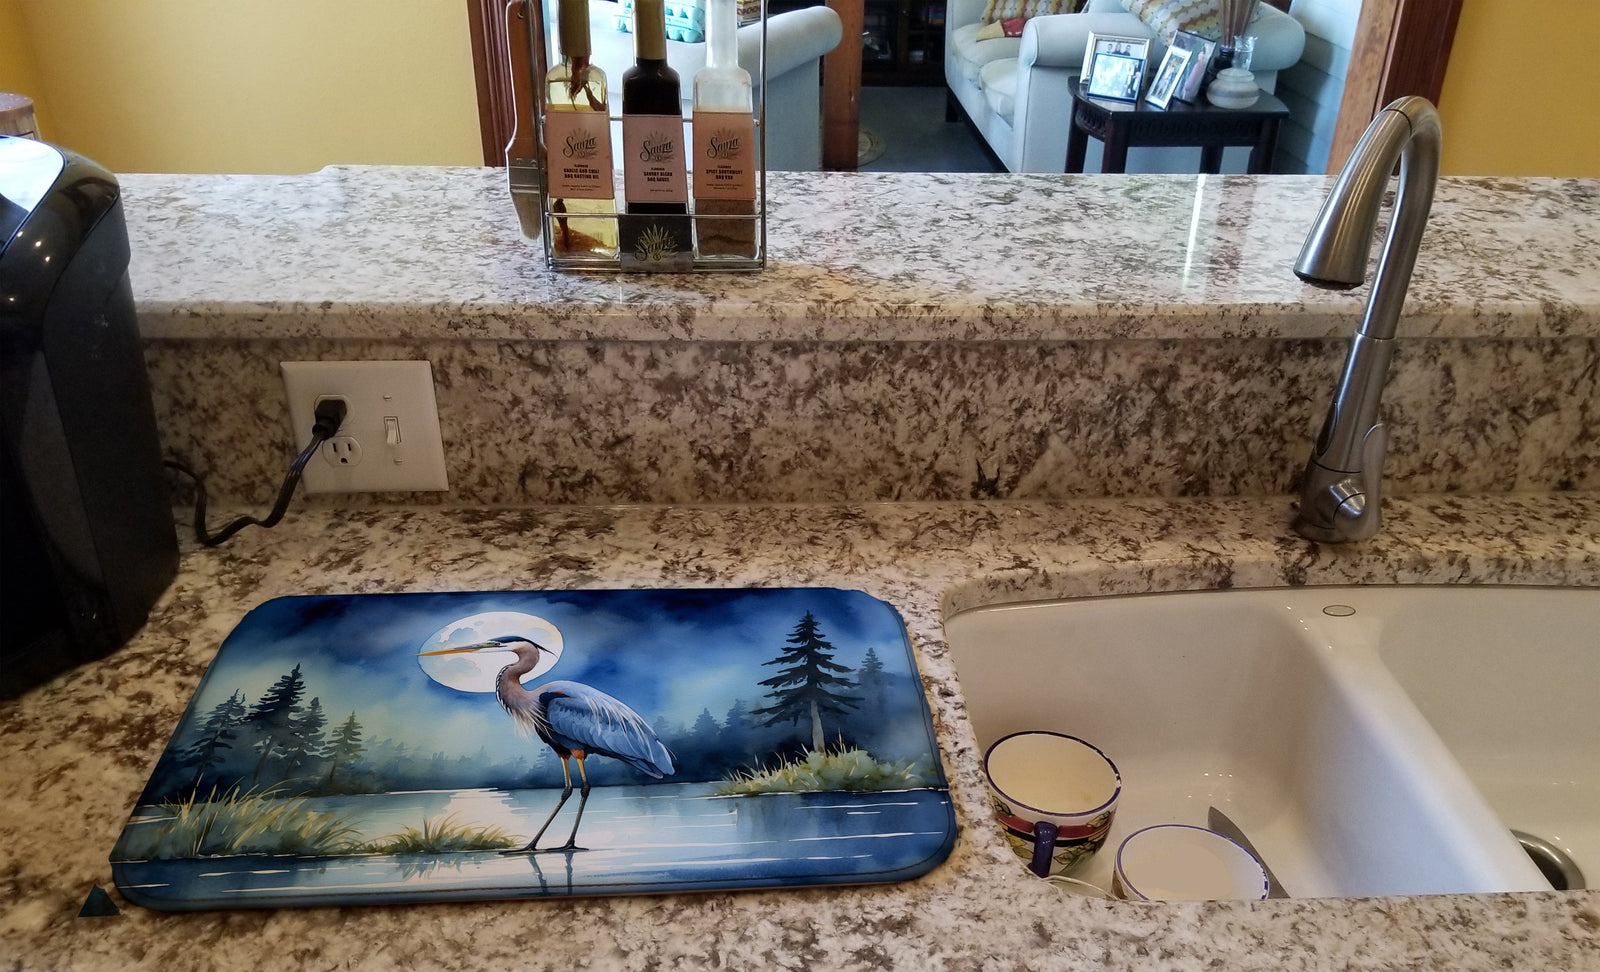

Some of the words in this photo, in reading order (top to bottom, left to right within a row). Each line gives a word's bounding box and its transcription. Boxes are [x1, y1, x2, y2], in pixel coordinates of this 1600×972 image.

[563, 135, 598, 158] Sauza
[640, 139, 674, 162] Sauza
[706, 136, 740, 159] Sauza
